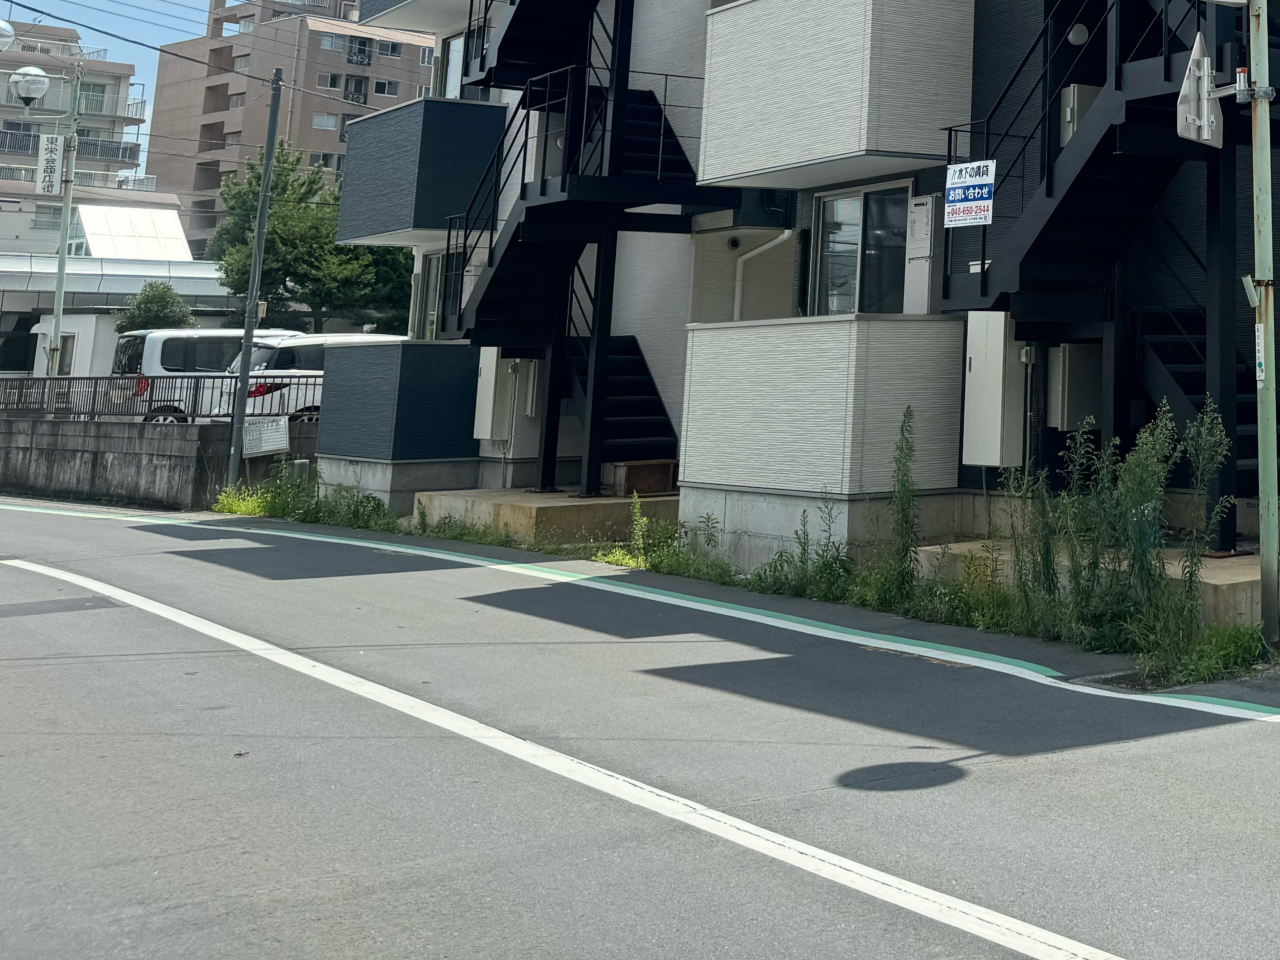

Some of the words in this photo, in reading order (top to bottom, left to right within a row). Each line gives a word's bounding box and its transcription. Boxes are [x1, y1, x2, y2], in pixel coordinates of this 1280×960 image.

[42, 136, 58, 193] 東栄会商店街
[949, 186, 989, 201] お問い合わせ
